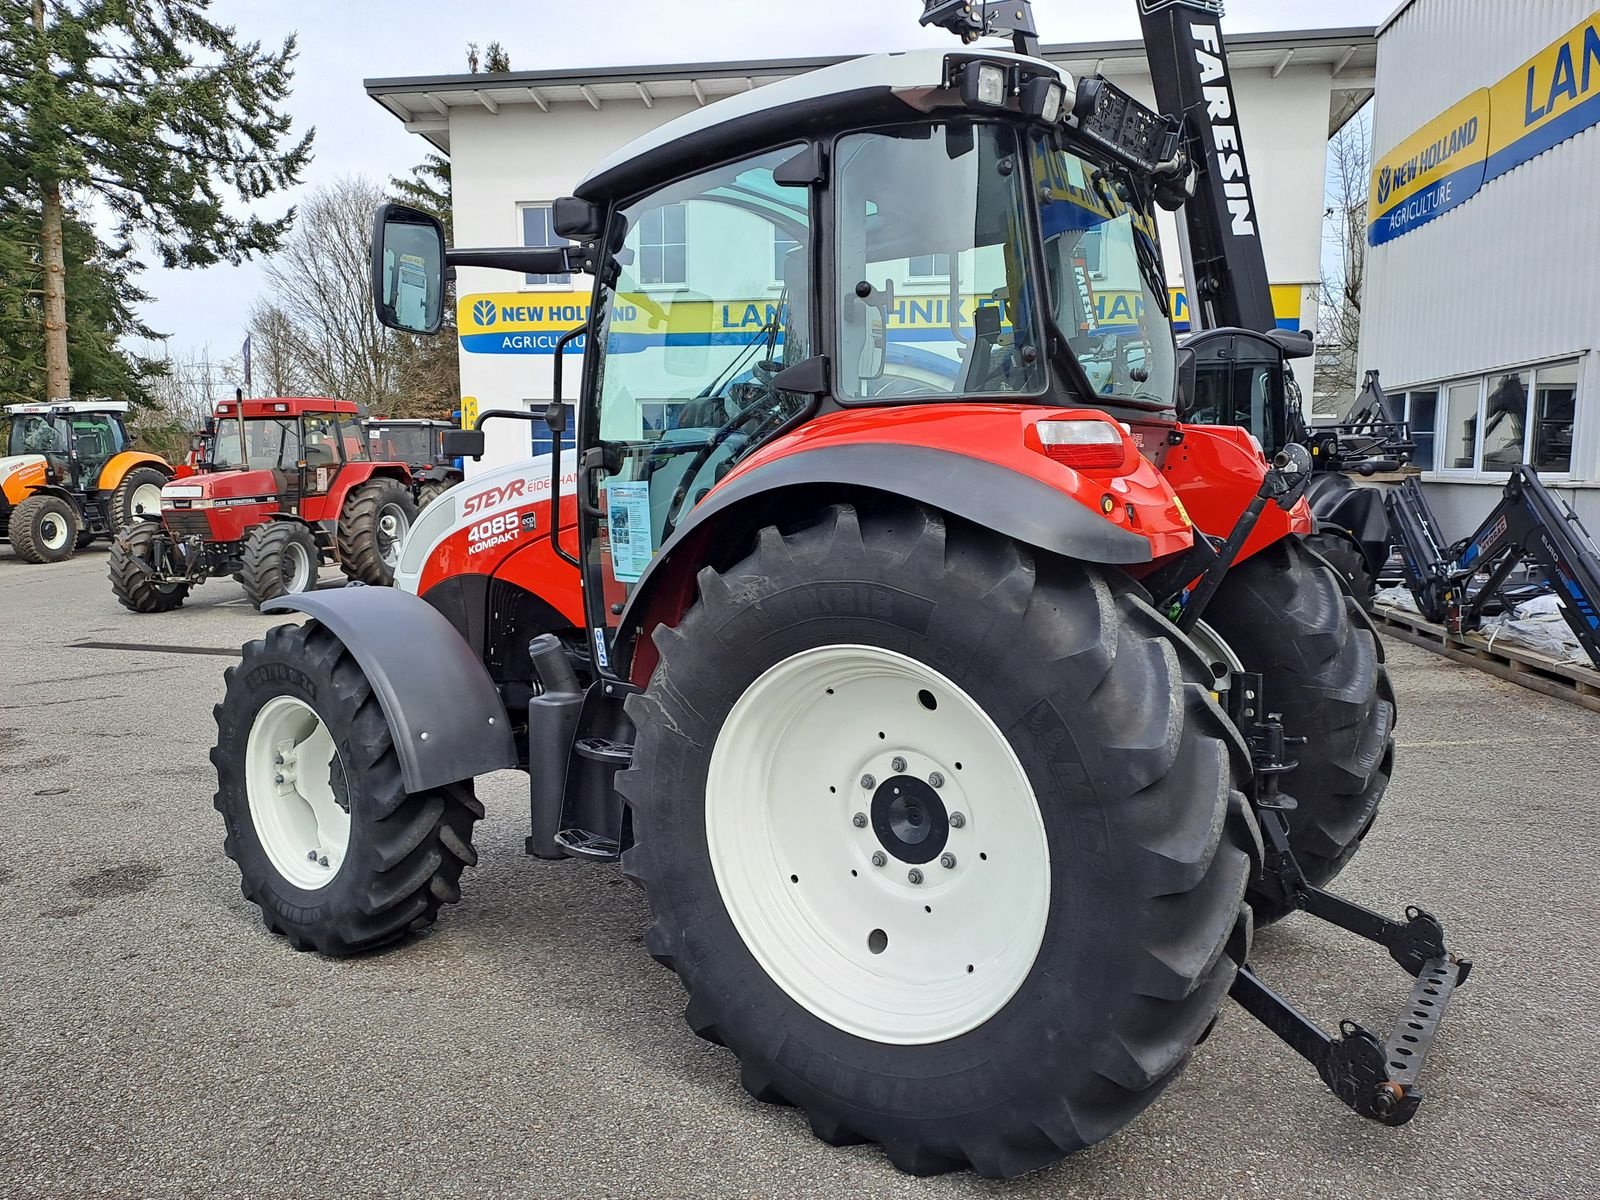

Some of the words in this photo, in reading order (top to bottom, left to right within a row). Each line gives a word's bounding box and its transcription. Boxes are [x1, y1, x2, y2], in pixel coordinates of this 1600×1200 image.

[1189, 22, 1256, 237] FARESIN
[1393, 156, 1418, 192] NEW
[1419, 116, 1478, 175] HOLLAND
[1389, 181, 1452, 232] AGRICULTURE
[502, 306, 544, 322] NEW
[1074, 266, 1096, 331] FARESIN
[462, 478, 526, 518] STEYR
[468, 511, 519, 543] 4085
[468, 528, 520, 555] KOMPAKT
